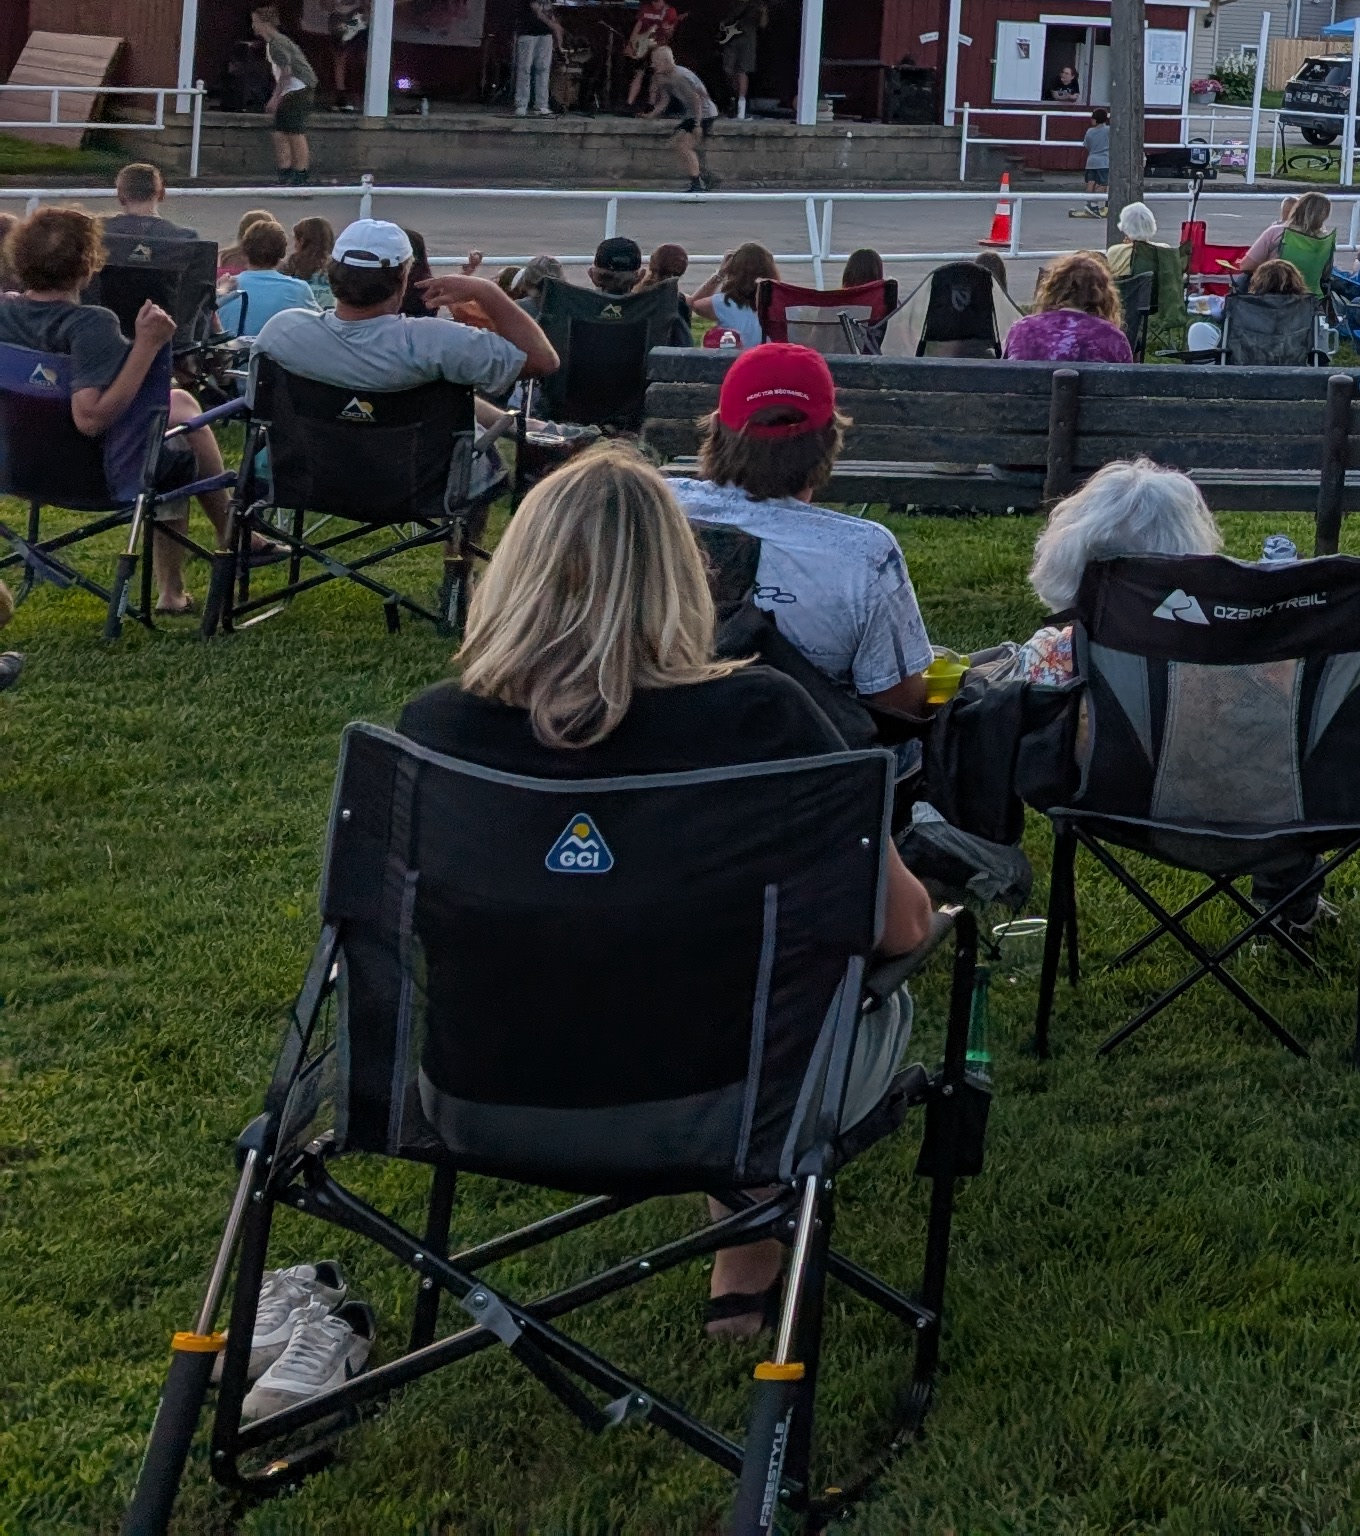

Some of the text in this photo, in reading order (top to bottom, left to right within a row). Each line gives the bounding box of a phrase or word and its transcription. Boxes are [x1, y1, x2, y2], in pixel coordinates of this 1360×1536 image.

[1213, 592, 1327, 620] OZARK TRAIL
[559, 851, 600, 867] GCI
[759, 1422, 785, 1527] FREESTYLE
